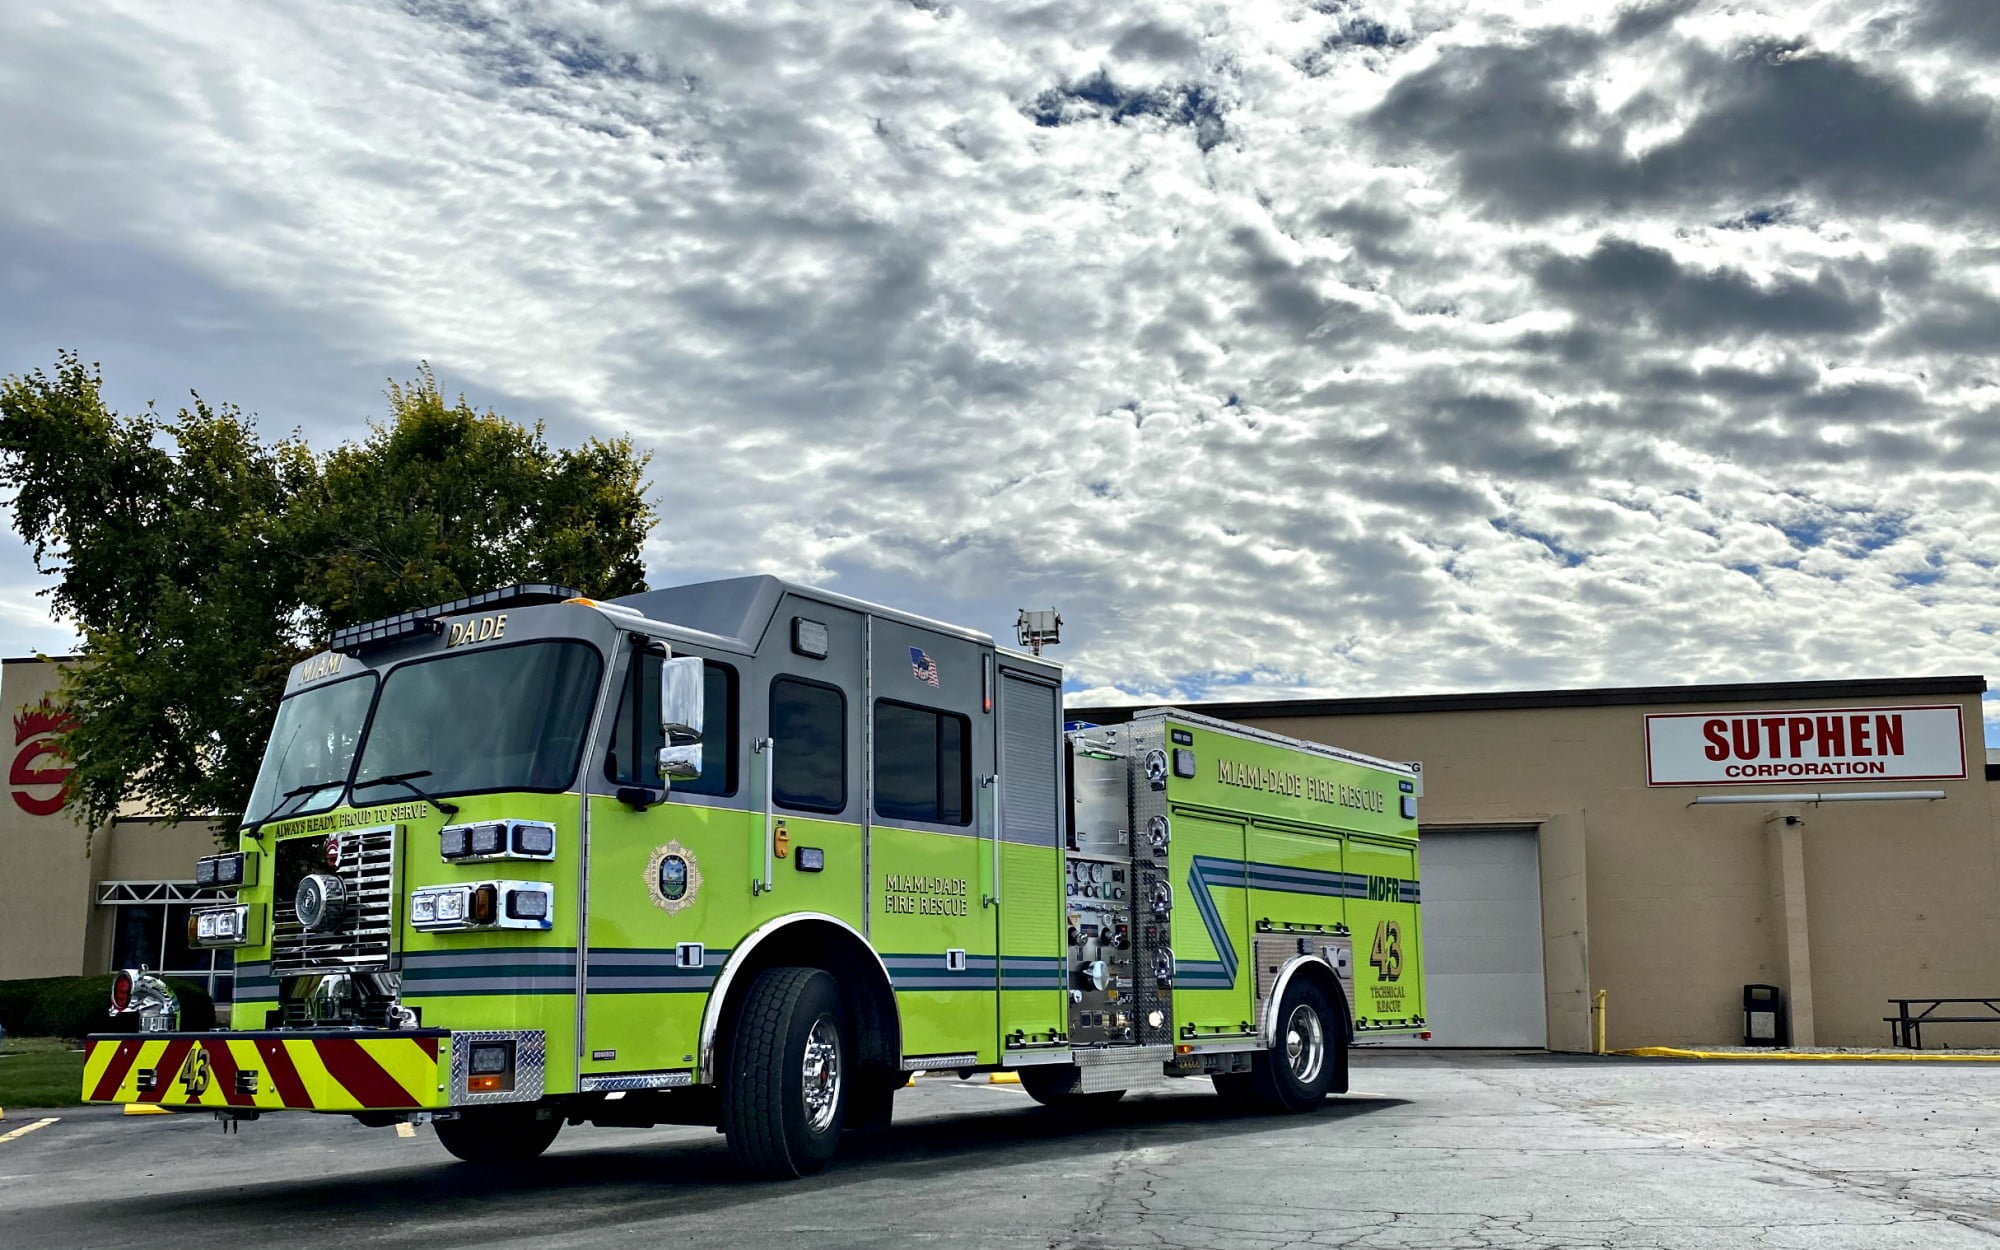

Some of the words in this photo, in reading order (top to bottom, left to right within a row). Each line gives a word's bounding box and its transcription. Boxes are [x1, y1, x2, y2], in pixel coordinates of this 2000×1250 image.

[446, 615, 507, 648] DADE
[299, 653, 343, 685] MIAMI
[1703, 714, 1904, 761] SUTPHEN
[1725, 761, 1885, 777] CORPORATION
[1218, 759, 1301, 797] MIAMI-DADE
[1307, 776, 1334, 803] FIRE
[1339, 784, 1383, 812] RESCUE
[275, 823, 305, 838] ALWAYS
[339, 810, 372, 827] PROUD
[375, 809, 387, 822] TO
[391, 804, 427, 821] SERVE
[885, 874, 966, 896] MIAMI-DADE
[1368, 875, 1400, 902] MDFR
[885, 895, 914, 914] FIRE
[920, 897, 967, 916] RESCUE
[1370, 920, 1403, 981] 43
[1370, 986, 1405, 999] TECHNICAL
[179, 1048, 210, 1096] 43
